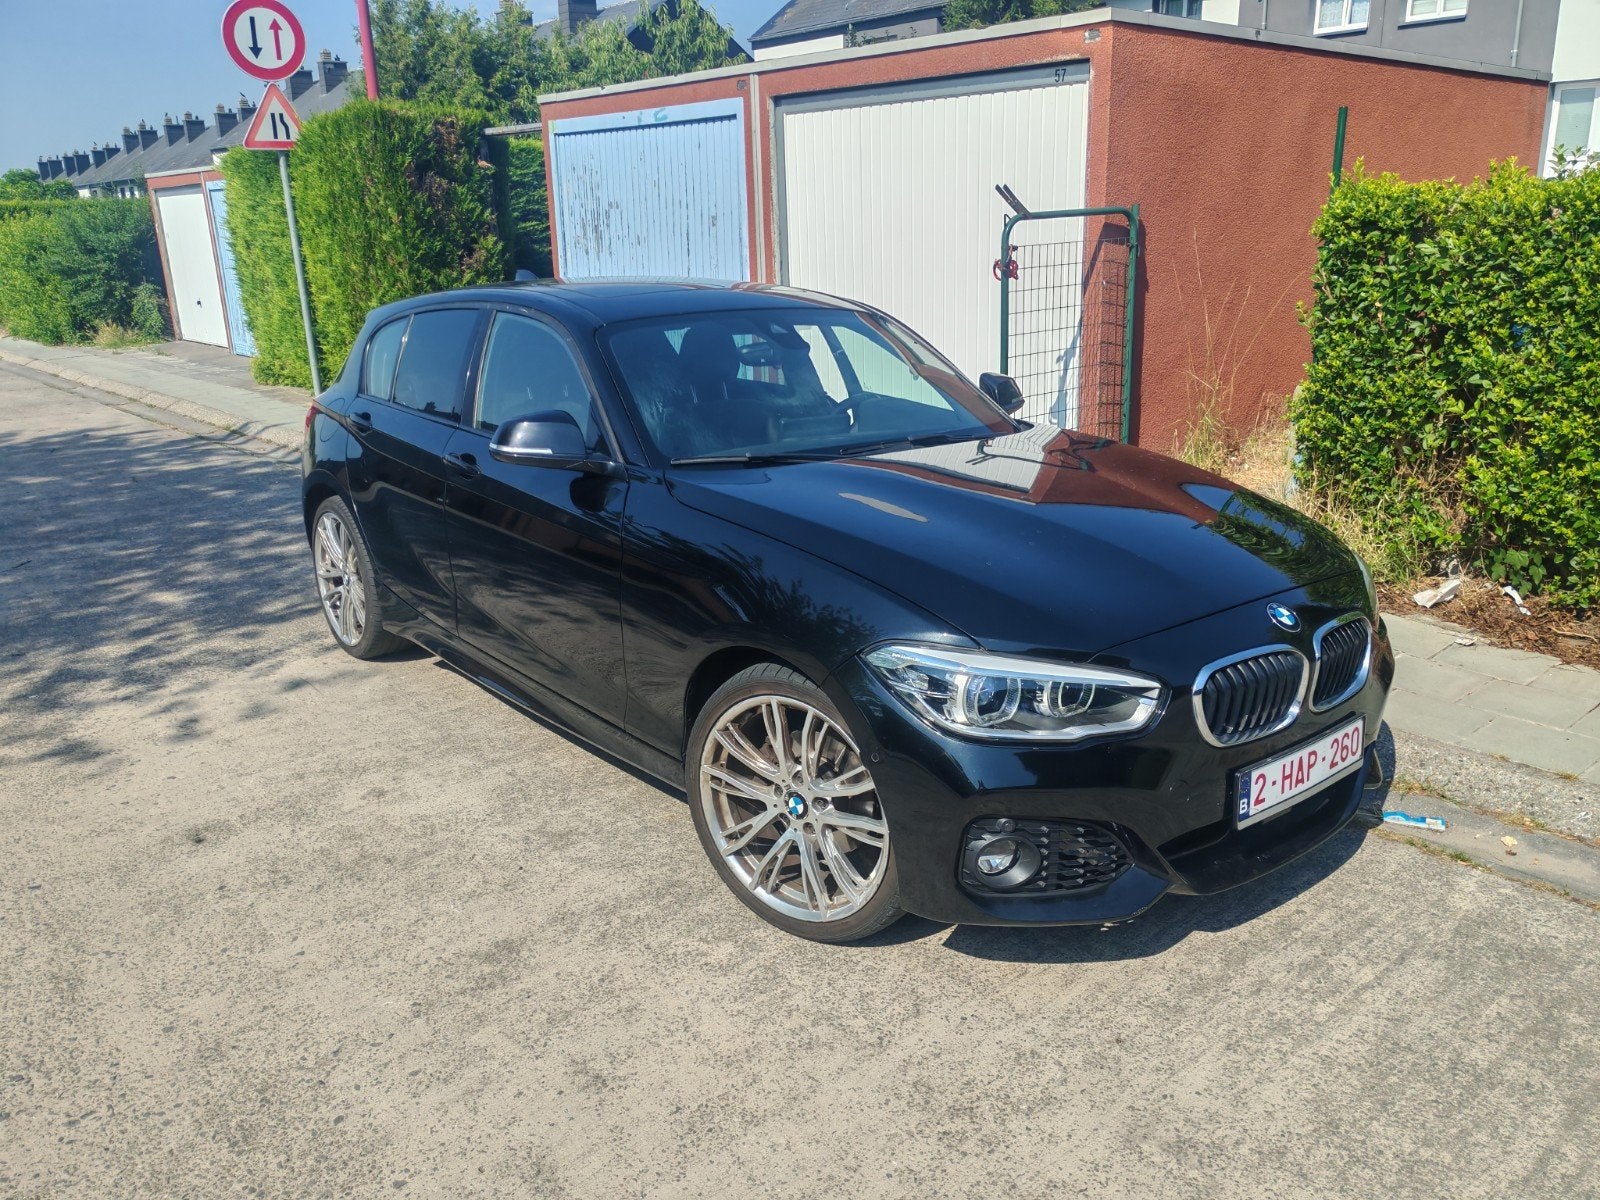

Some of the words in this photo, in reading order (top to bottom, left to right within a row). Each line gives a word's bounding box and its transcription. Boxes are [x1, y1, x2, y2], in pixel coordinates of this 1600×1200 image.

[1055, 68, 1066, 82] 57
[1253, 726, 1360, 807] 2-HAP-260
[1239, 798, 1248, 815] B
